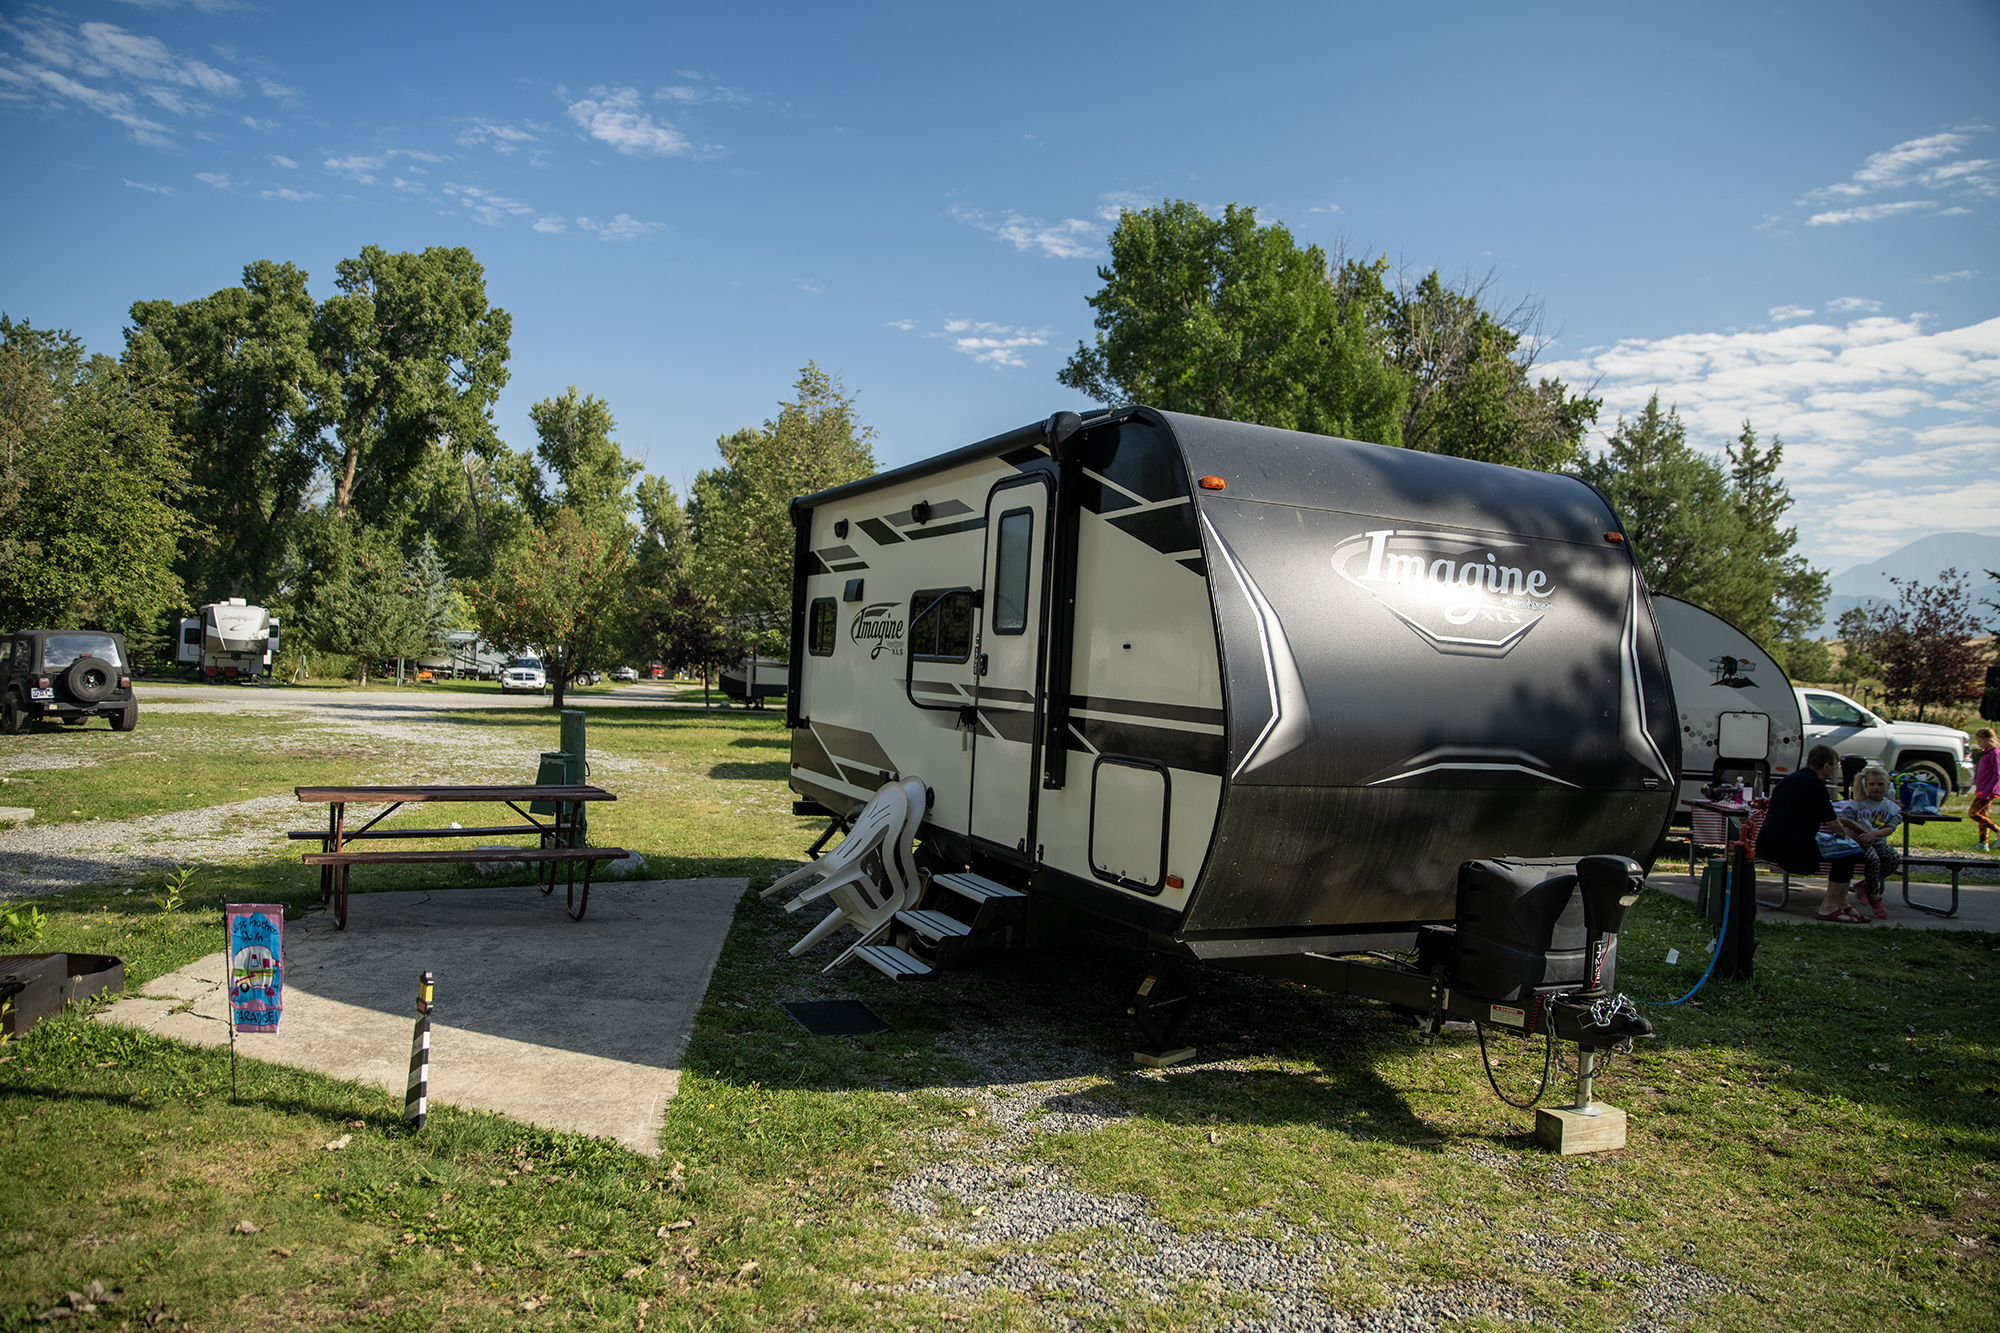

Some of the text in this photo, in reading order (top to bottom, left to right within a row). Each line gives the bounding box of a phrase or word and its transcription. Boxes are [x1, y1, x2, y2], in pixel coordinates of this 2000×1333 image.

[1358, 530, 1557, 625] Imagine
[855, 606, 905, 660] Imagine
[1481, 610, 1522, 624] XLS
[236, 1010, 278, 1024] ARADSE!
